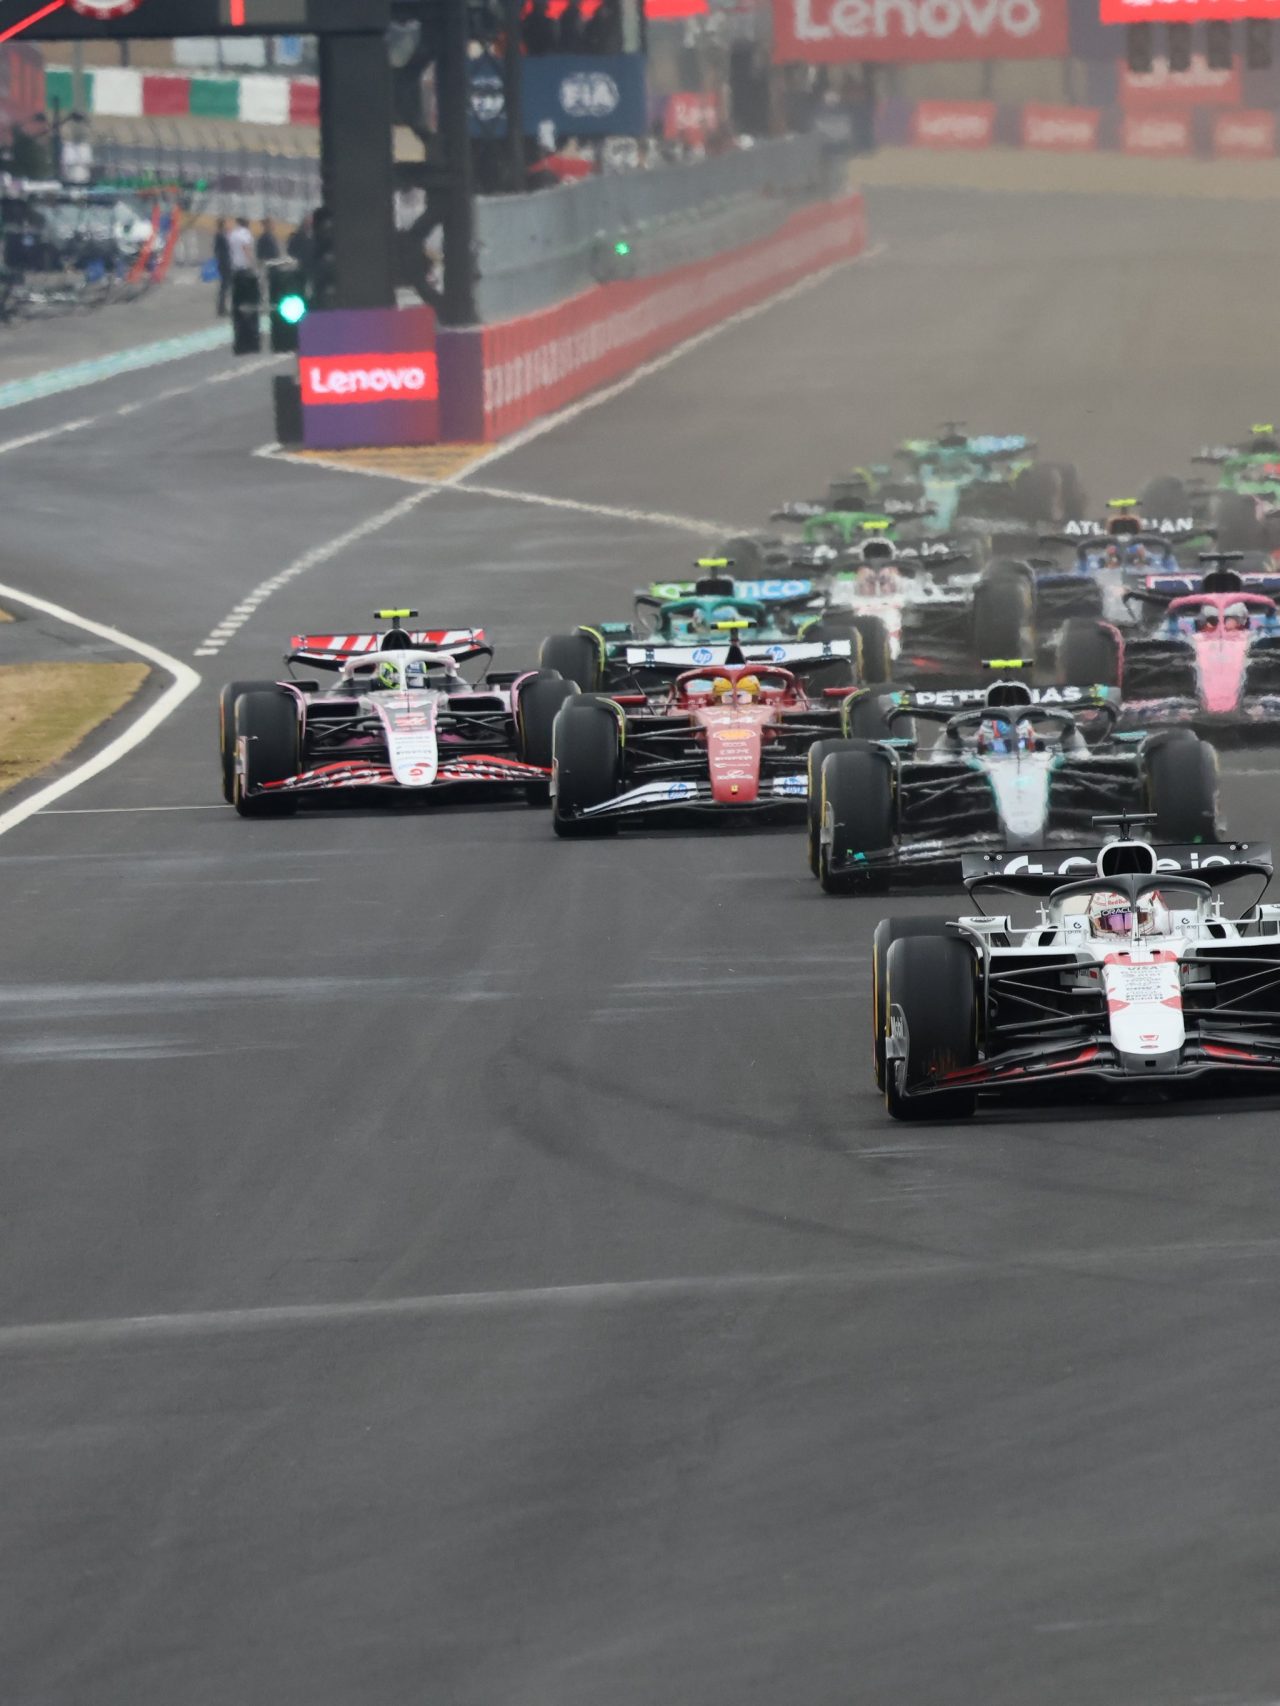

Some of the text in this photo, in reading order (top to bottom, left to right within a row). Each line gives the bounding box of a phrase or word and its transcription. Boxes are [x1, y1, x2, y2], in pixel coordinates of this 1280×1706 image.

[794, 0, 1041, 41] Lenovo
[310, 366, 426, 394] Lenovo
[915, 686, 1083, 706] PETAS
[1101, 907, 1132, 916] ORACL
